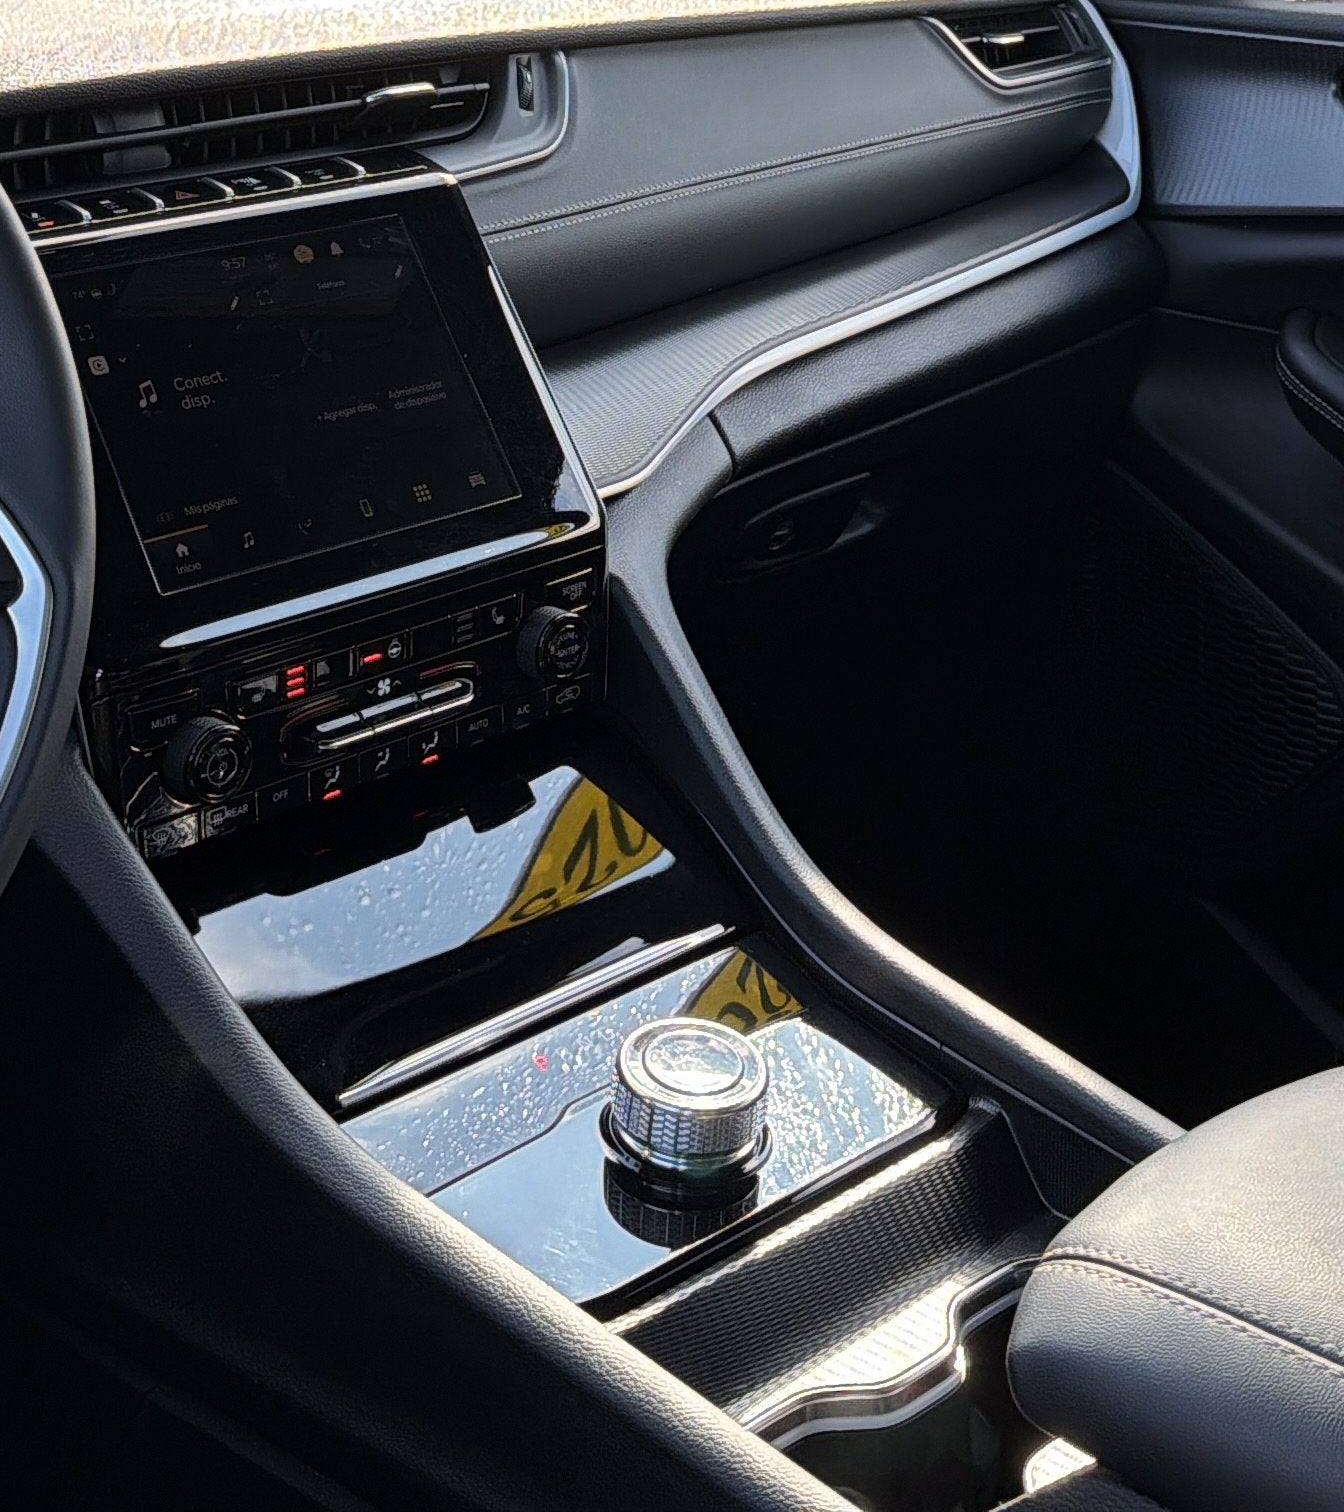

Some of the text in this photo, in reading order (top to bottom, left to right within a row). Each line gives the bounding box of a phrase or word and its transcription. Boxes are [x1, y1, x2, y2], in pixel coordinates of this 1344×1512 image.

[220, 256, 247, 272] 9:57
[173, 370, 229, 392] Conect.
[181, 393, 216, 410] disp.
[183, 504, 203, 518] Mis
[175, 560, 203, 576] Inicio
[562, 580, 588, 596] SCREEN
[569, 589, 584, 601] OFF
[516, 703, 531, 716] A/C
[150, 713, 179, 730] MUTE
[468, 717, 490, 732] AUTO
[272, 789, 290, 803] OFF
[224, 803, 250, 819] REAR
